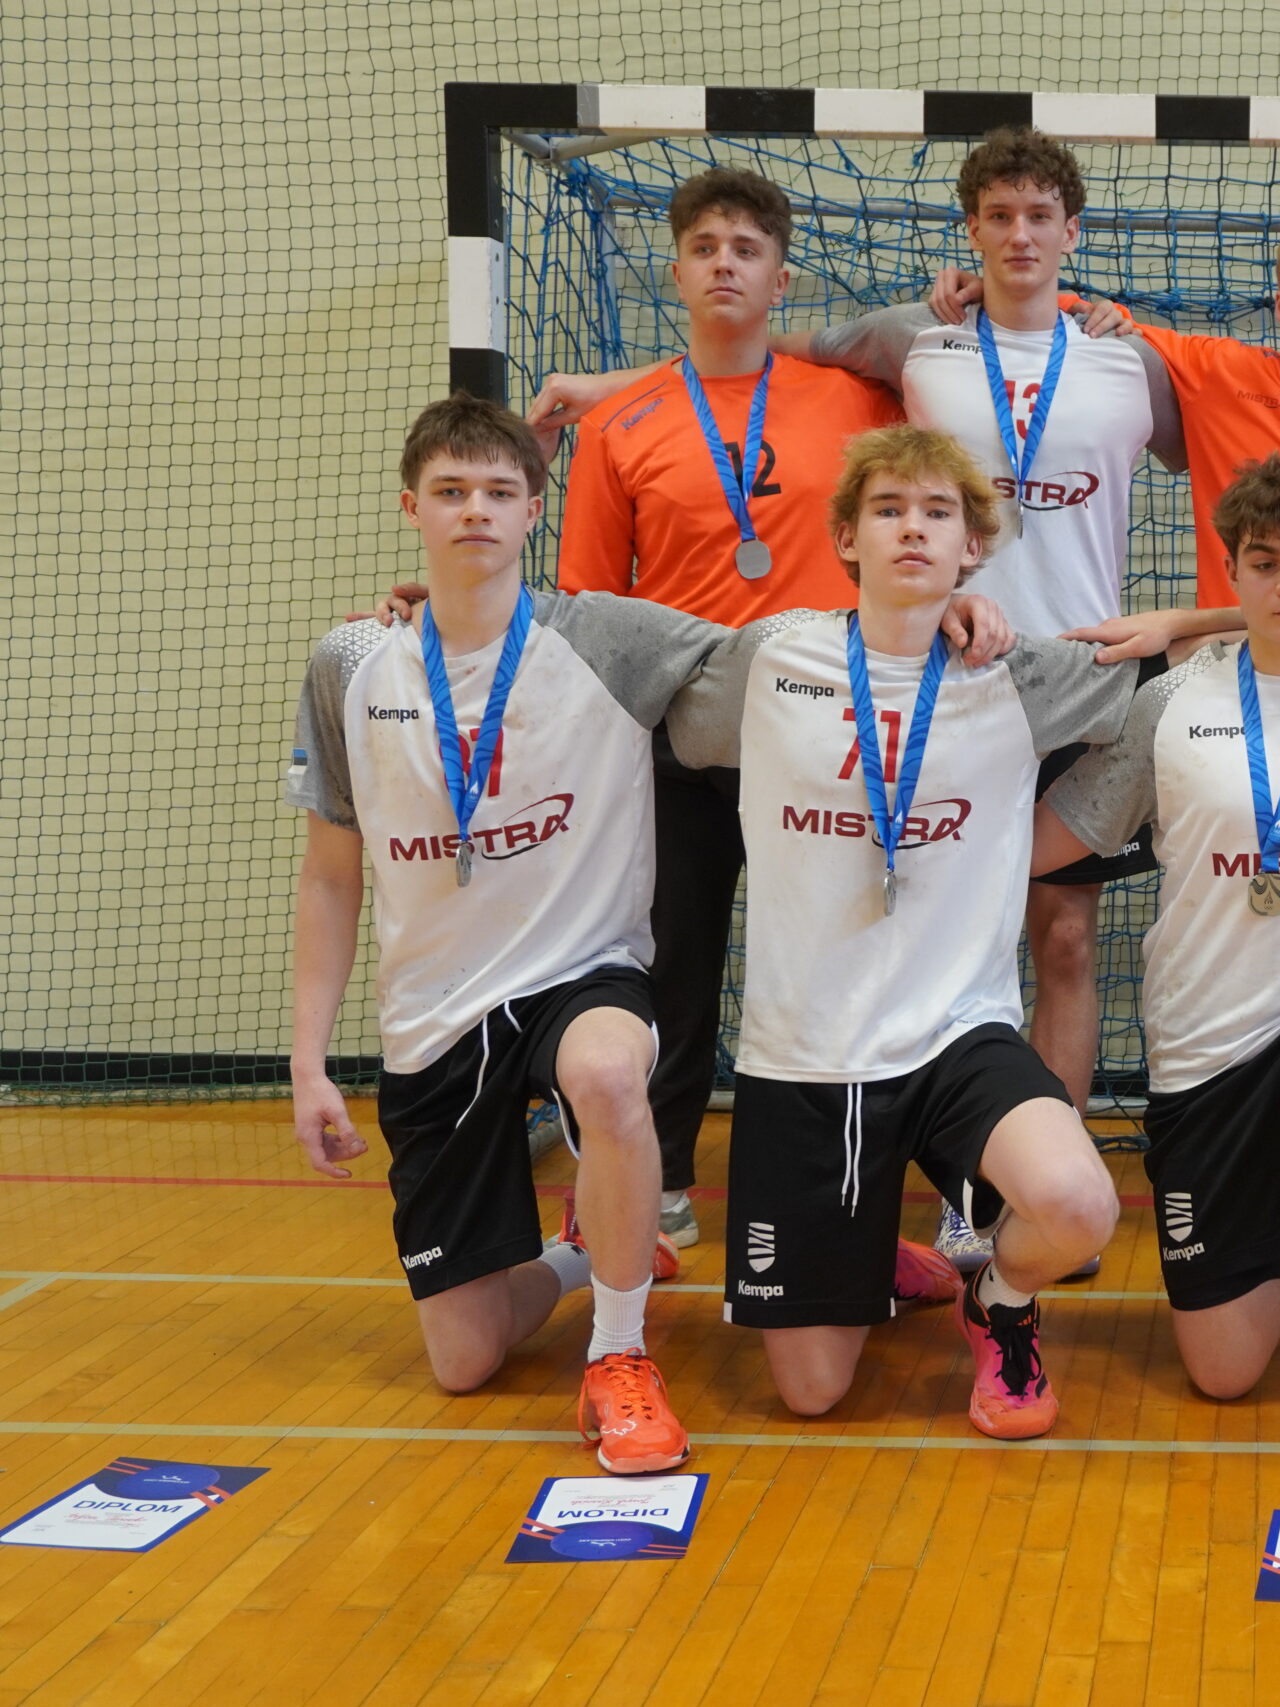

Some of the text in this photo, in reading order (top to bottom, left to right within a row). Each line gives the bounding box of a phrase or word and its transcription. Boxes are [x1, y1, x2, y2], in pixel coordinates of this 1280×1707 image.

[943, 338, 984, 357] Kemp
[621, 397, 664, 431] Kempa
[991, 475, 1090, 508] STRA
[776, 677, 835, 700] Kempa
[367, 705, 420, 724] Kempa
[401, 1245, 443, 1270] Kempa
[1162, 1241, 1206, 1262] Kempa
[738, 1279, 784, 1301] Kempa
[72, 1500, 183, 1513] DIPLOM
[557, 1508, 670, 1519] DIPLOM
